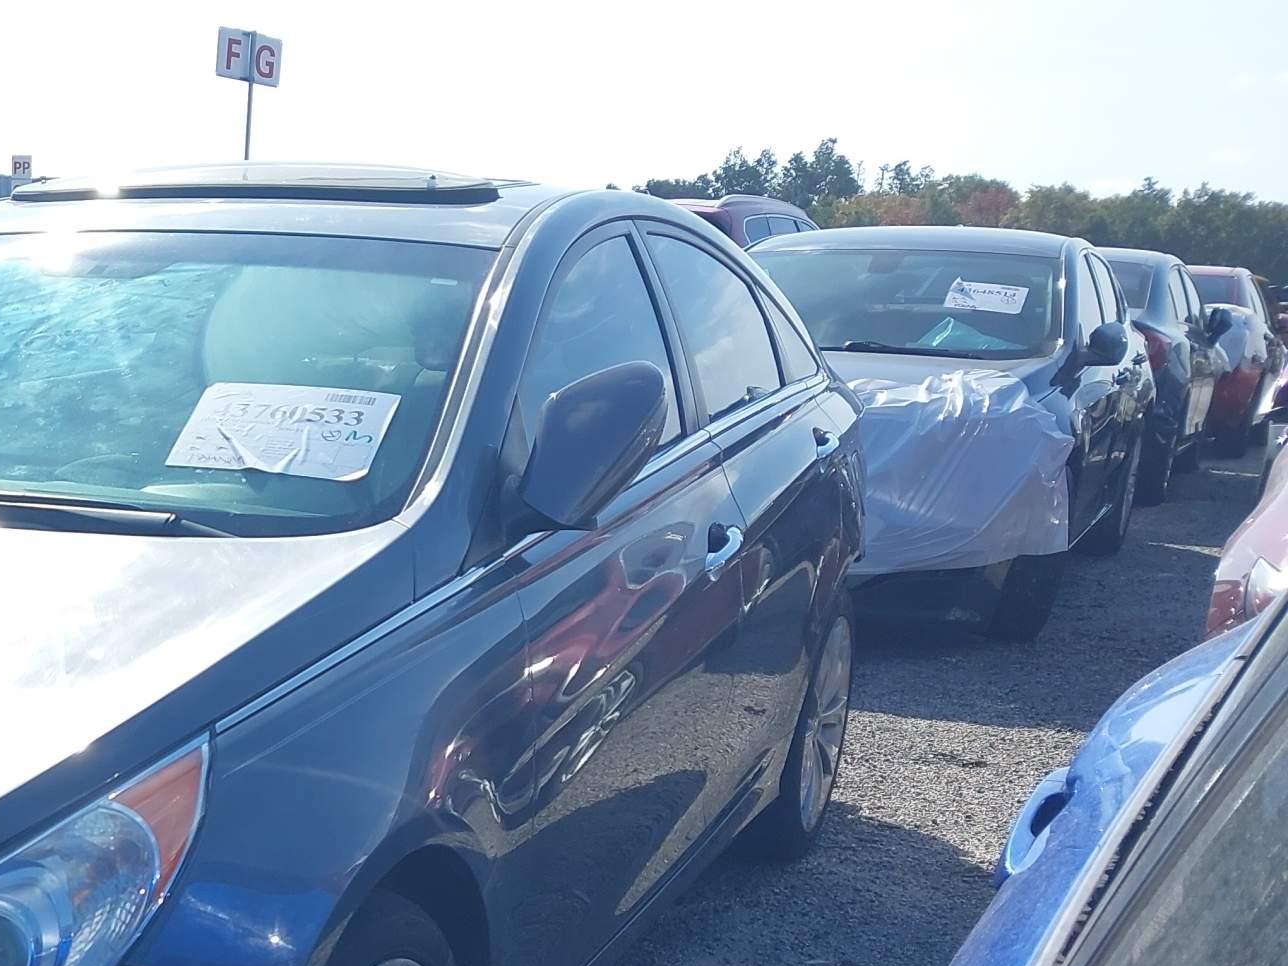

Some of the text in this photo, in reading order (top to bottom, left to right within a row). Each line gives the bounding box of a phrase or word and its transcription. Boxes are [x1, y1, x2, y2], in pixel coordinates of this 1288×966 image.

[226, 38, 242, 70] F
[255, 45, 276, 79] G
[14, 161, 31, 175] PP
